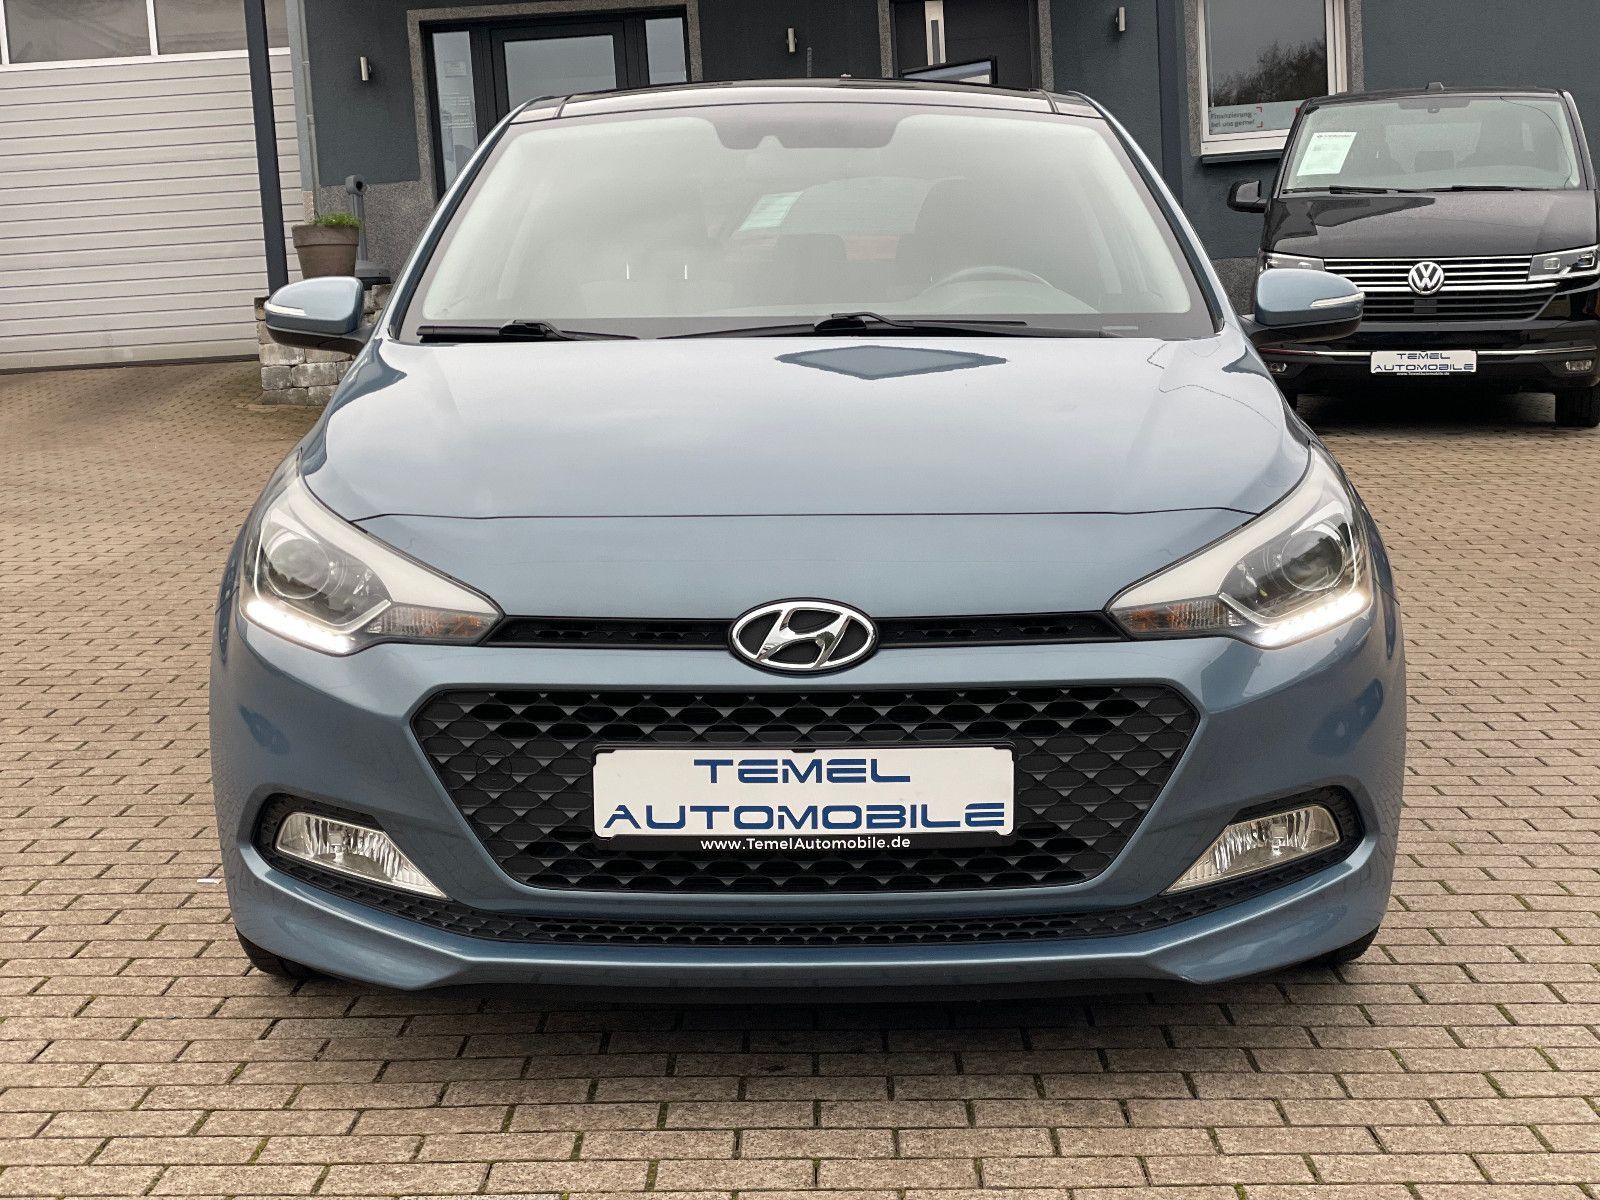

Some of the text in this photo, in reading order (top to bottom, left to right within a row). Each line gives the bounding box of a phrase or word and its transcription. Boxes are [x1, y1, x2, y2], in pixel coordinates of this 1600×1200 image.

[1409, 262, 1443, 294] VW
[1396, 352, 1450, 360] TEMEL
[1373, 363, 1474, 371] AUTOMOBILE
[694, 758, 910, 784] TEMEL
[603, 802, 1005, 830] AUTOMOBILE
[700, 836, 911, 850] www.TemelAutomobile.de
